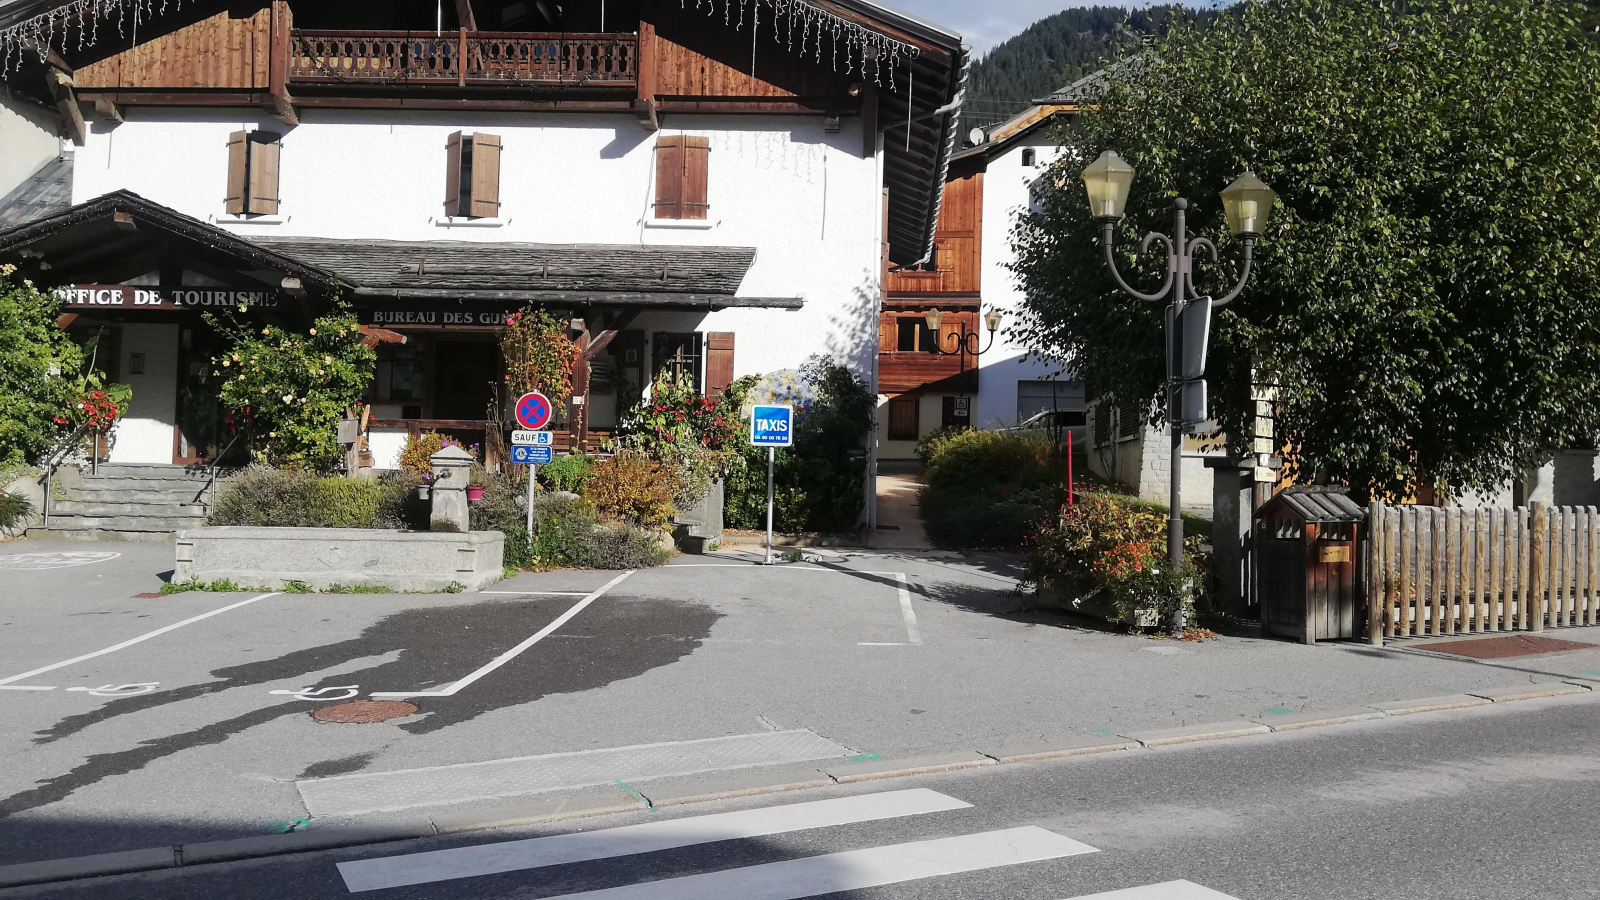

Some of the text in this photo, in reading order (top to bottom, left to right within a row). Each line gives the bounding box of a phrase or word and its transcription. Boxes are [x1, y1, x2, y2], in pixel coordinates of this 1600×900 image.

[133, 289, 162, 306] DE
[171, 290, 278, 306] TOURISME
[373, 311, 436, 323] BUREAU
[443, 312, 474, 324] DES
[756, 419, 787, 431] TAXIS
[515, 434, 537, 442] SAUF
